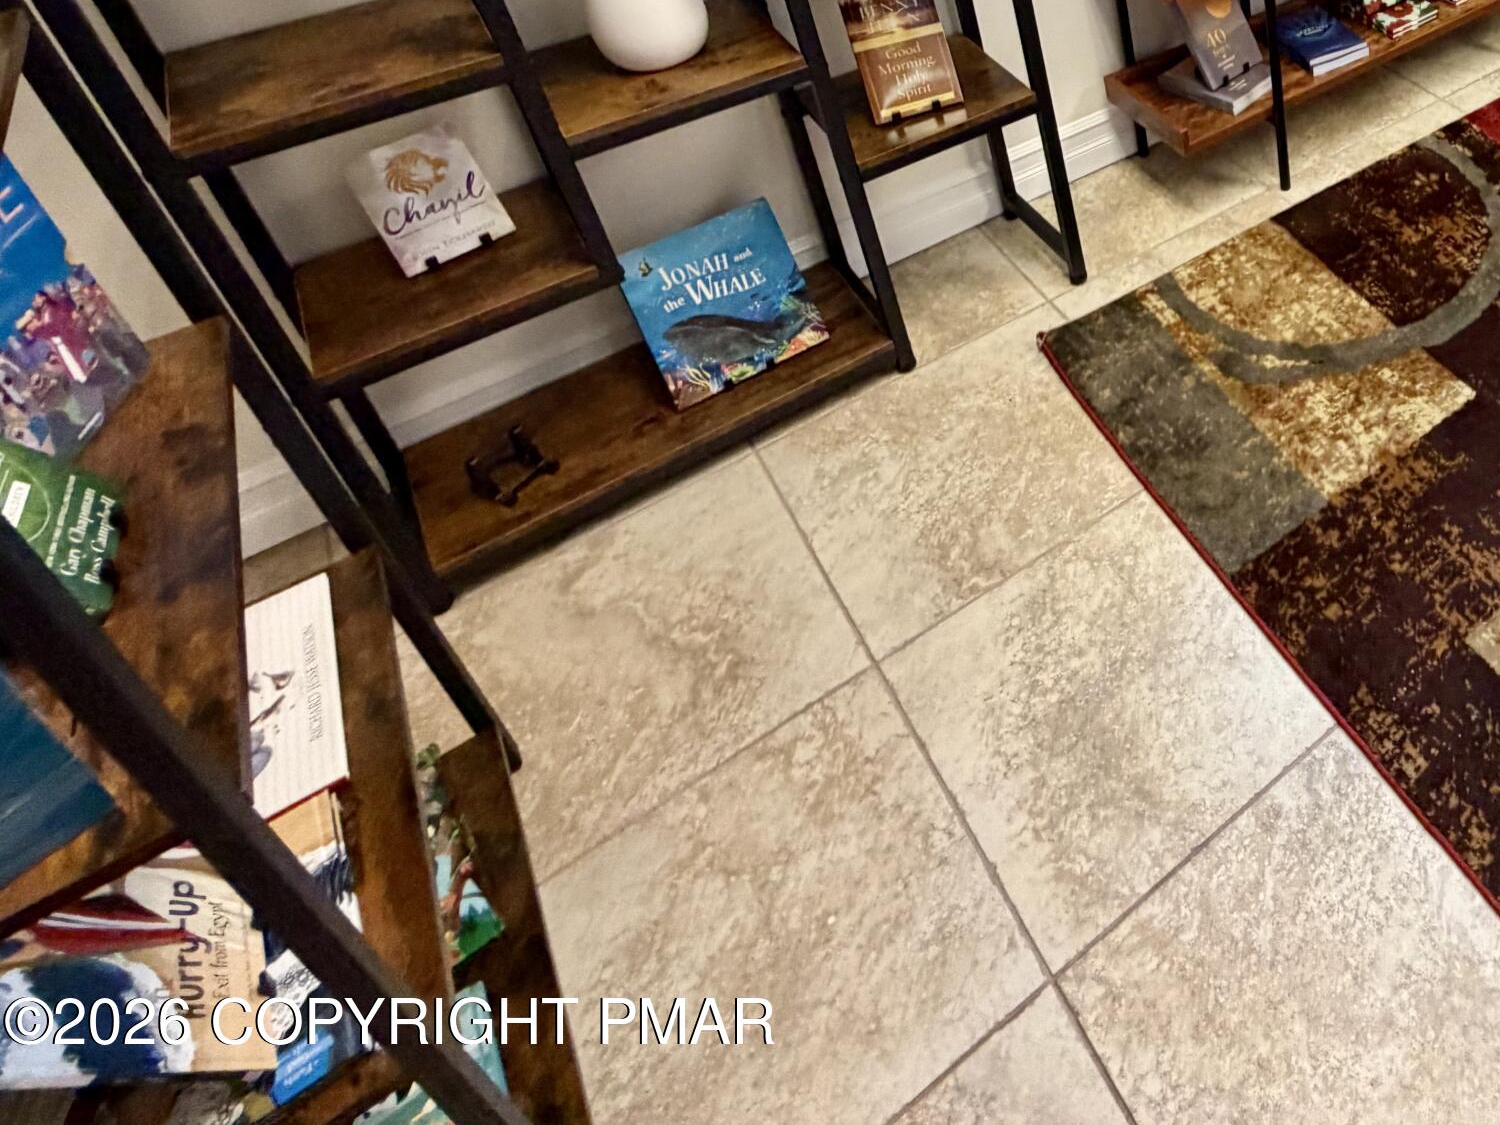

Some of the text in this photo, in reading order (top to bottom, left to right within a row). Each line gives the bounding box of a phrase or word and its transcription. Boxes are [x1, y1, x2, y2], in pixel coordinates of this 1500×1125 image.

[877, 54, 937, 76] Morning
[884, 42, 922, 60] Good
[895, 69, 928, 87] Holy
[896, 83, 932, 101] Spirit
[657, 247, 753, 291] JONAH and
[663, 267, 767, 314] the WHALE
[68, 486, 96, 544] Chapman
[60, 547, 86, 576] Gary
[211, 941, 230, 969] from
